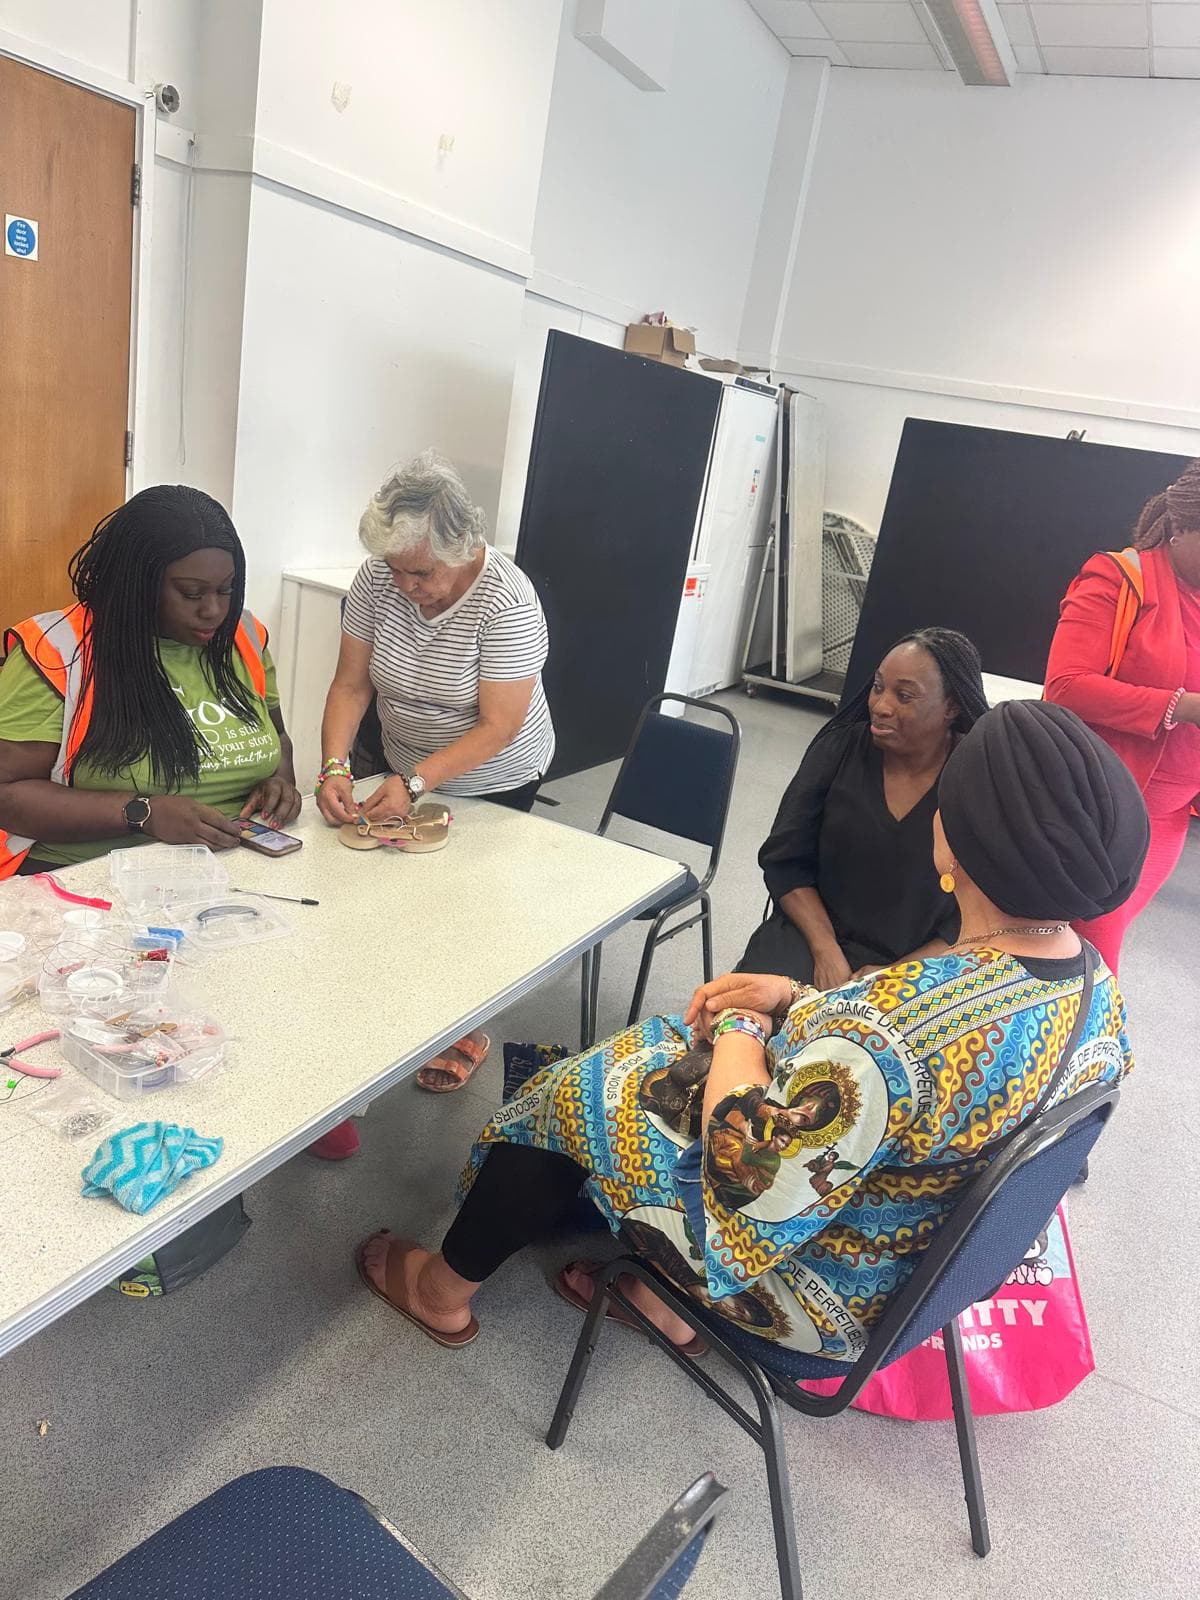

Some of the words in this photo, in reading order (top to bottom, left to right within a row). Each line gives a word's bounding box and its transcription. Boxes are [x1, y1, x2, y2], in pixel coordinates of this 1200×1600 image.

[224, 727, 238, 740] is
[217, 741, 245, 757] your
[835, 1001, 877, 1021] DAME
[1077, 1048, 1091, 1066] DE
[607, 1075, 621, 1100] NOUS
[494, 1092, 540, 1124] SECOURS
[958, 1299, 1048, 1328] ITTY
[921, 1332, 1003, 1351] FRNDS
